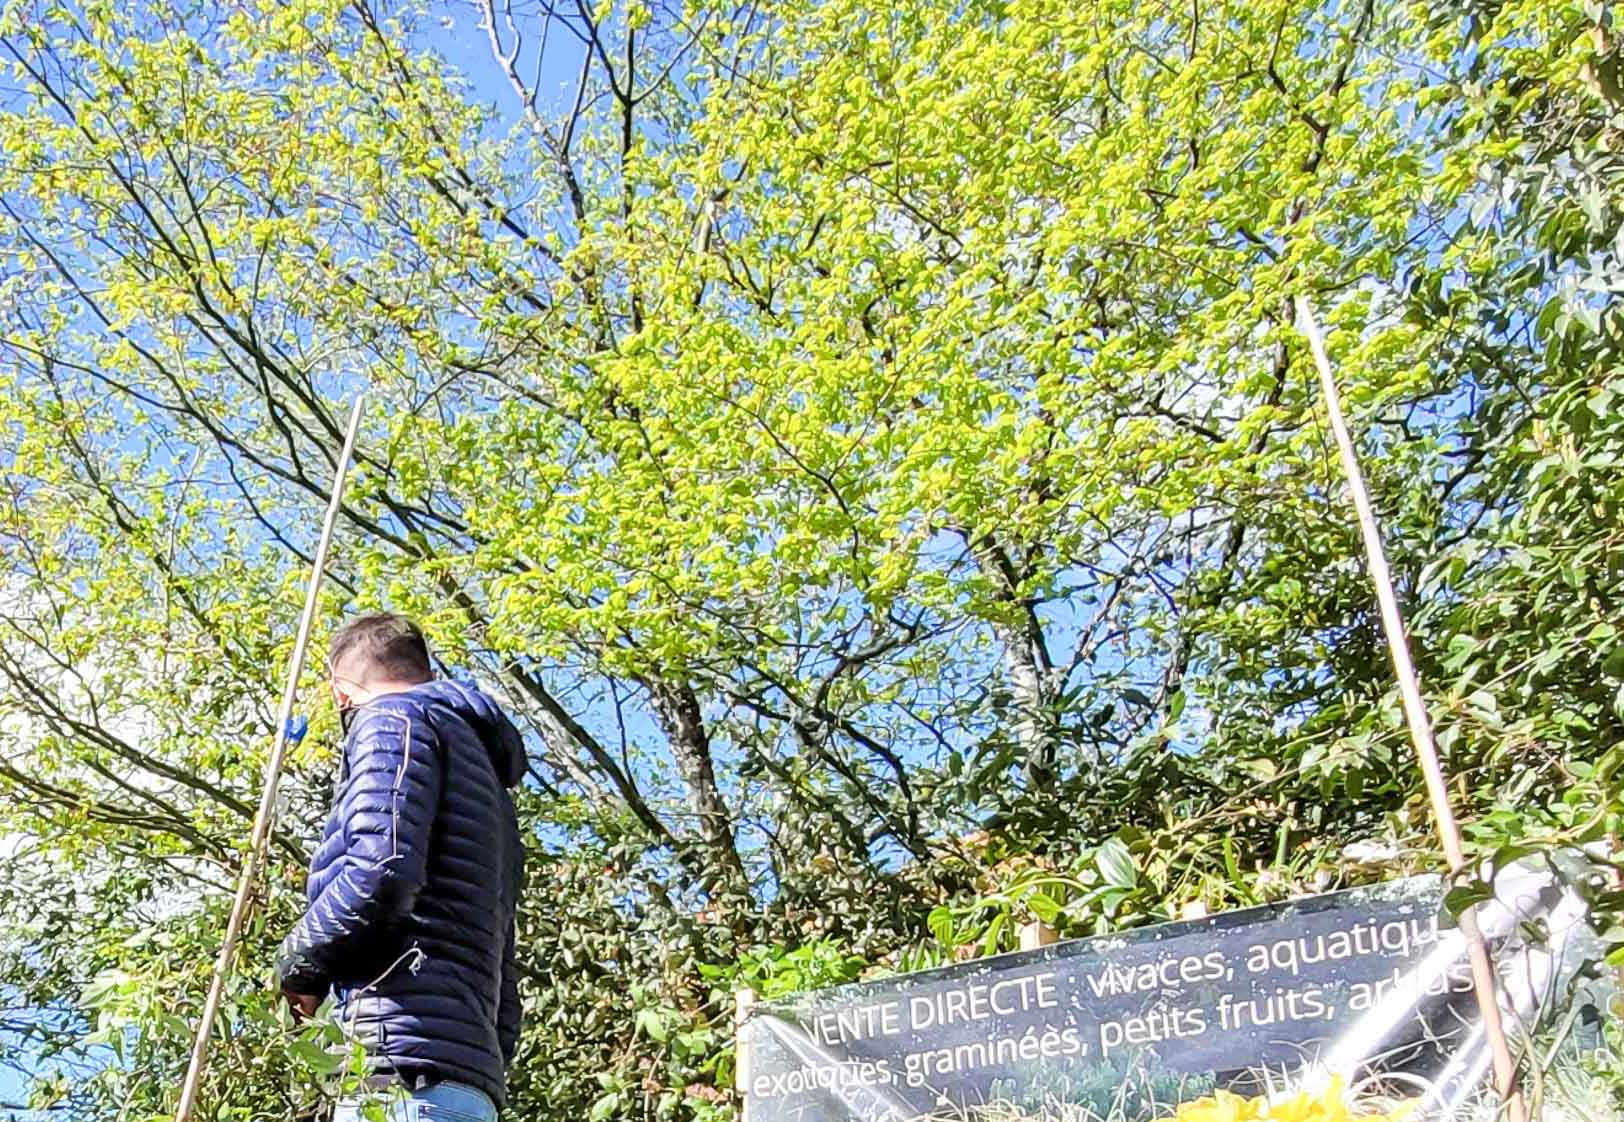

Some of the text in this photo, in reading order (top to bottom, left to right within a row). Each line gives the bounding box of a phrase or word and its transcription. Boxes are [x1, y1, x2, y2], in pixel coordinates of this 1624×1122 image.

[800, 1002, 901, 1048] VENTE
[910, 972, 1057, 1030] DIRECTE
[1248, 914, 1441, 975] aquatiqu
[1100, 995, 1207, 1056] petits
[1218, 986, 1336, 1030] fruits,
